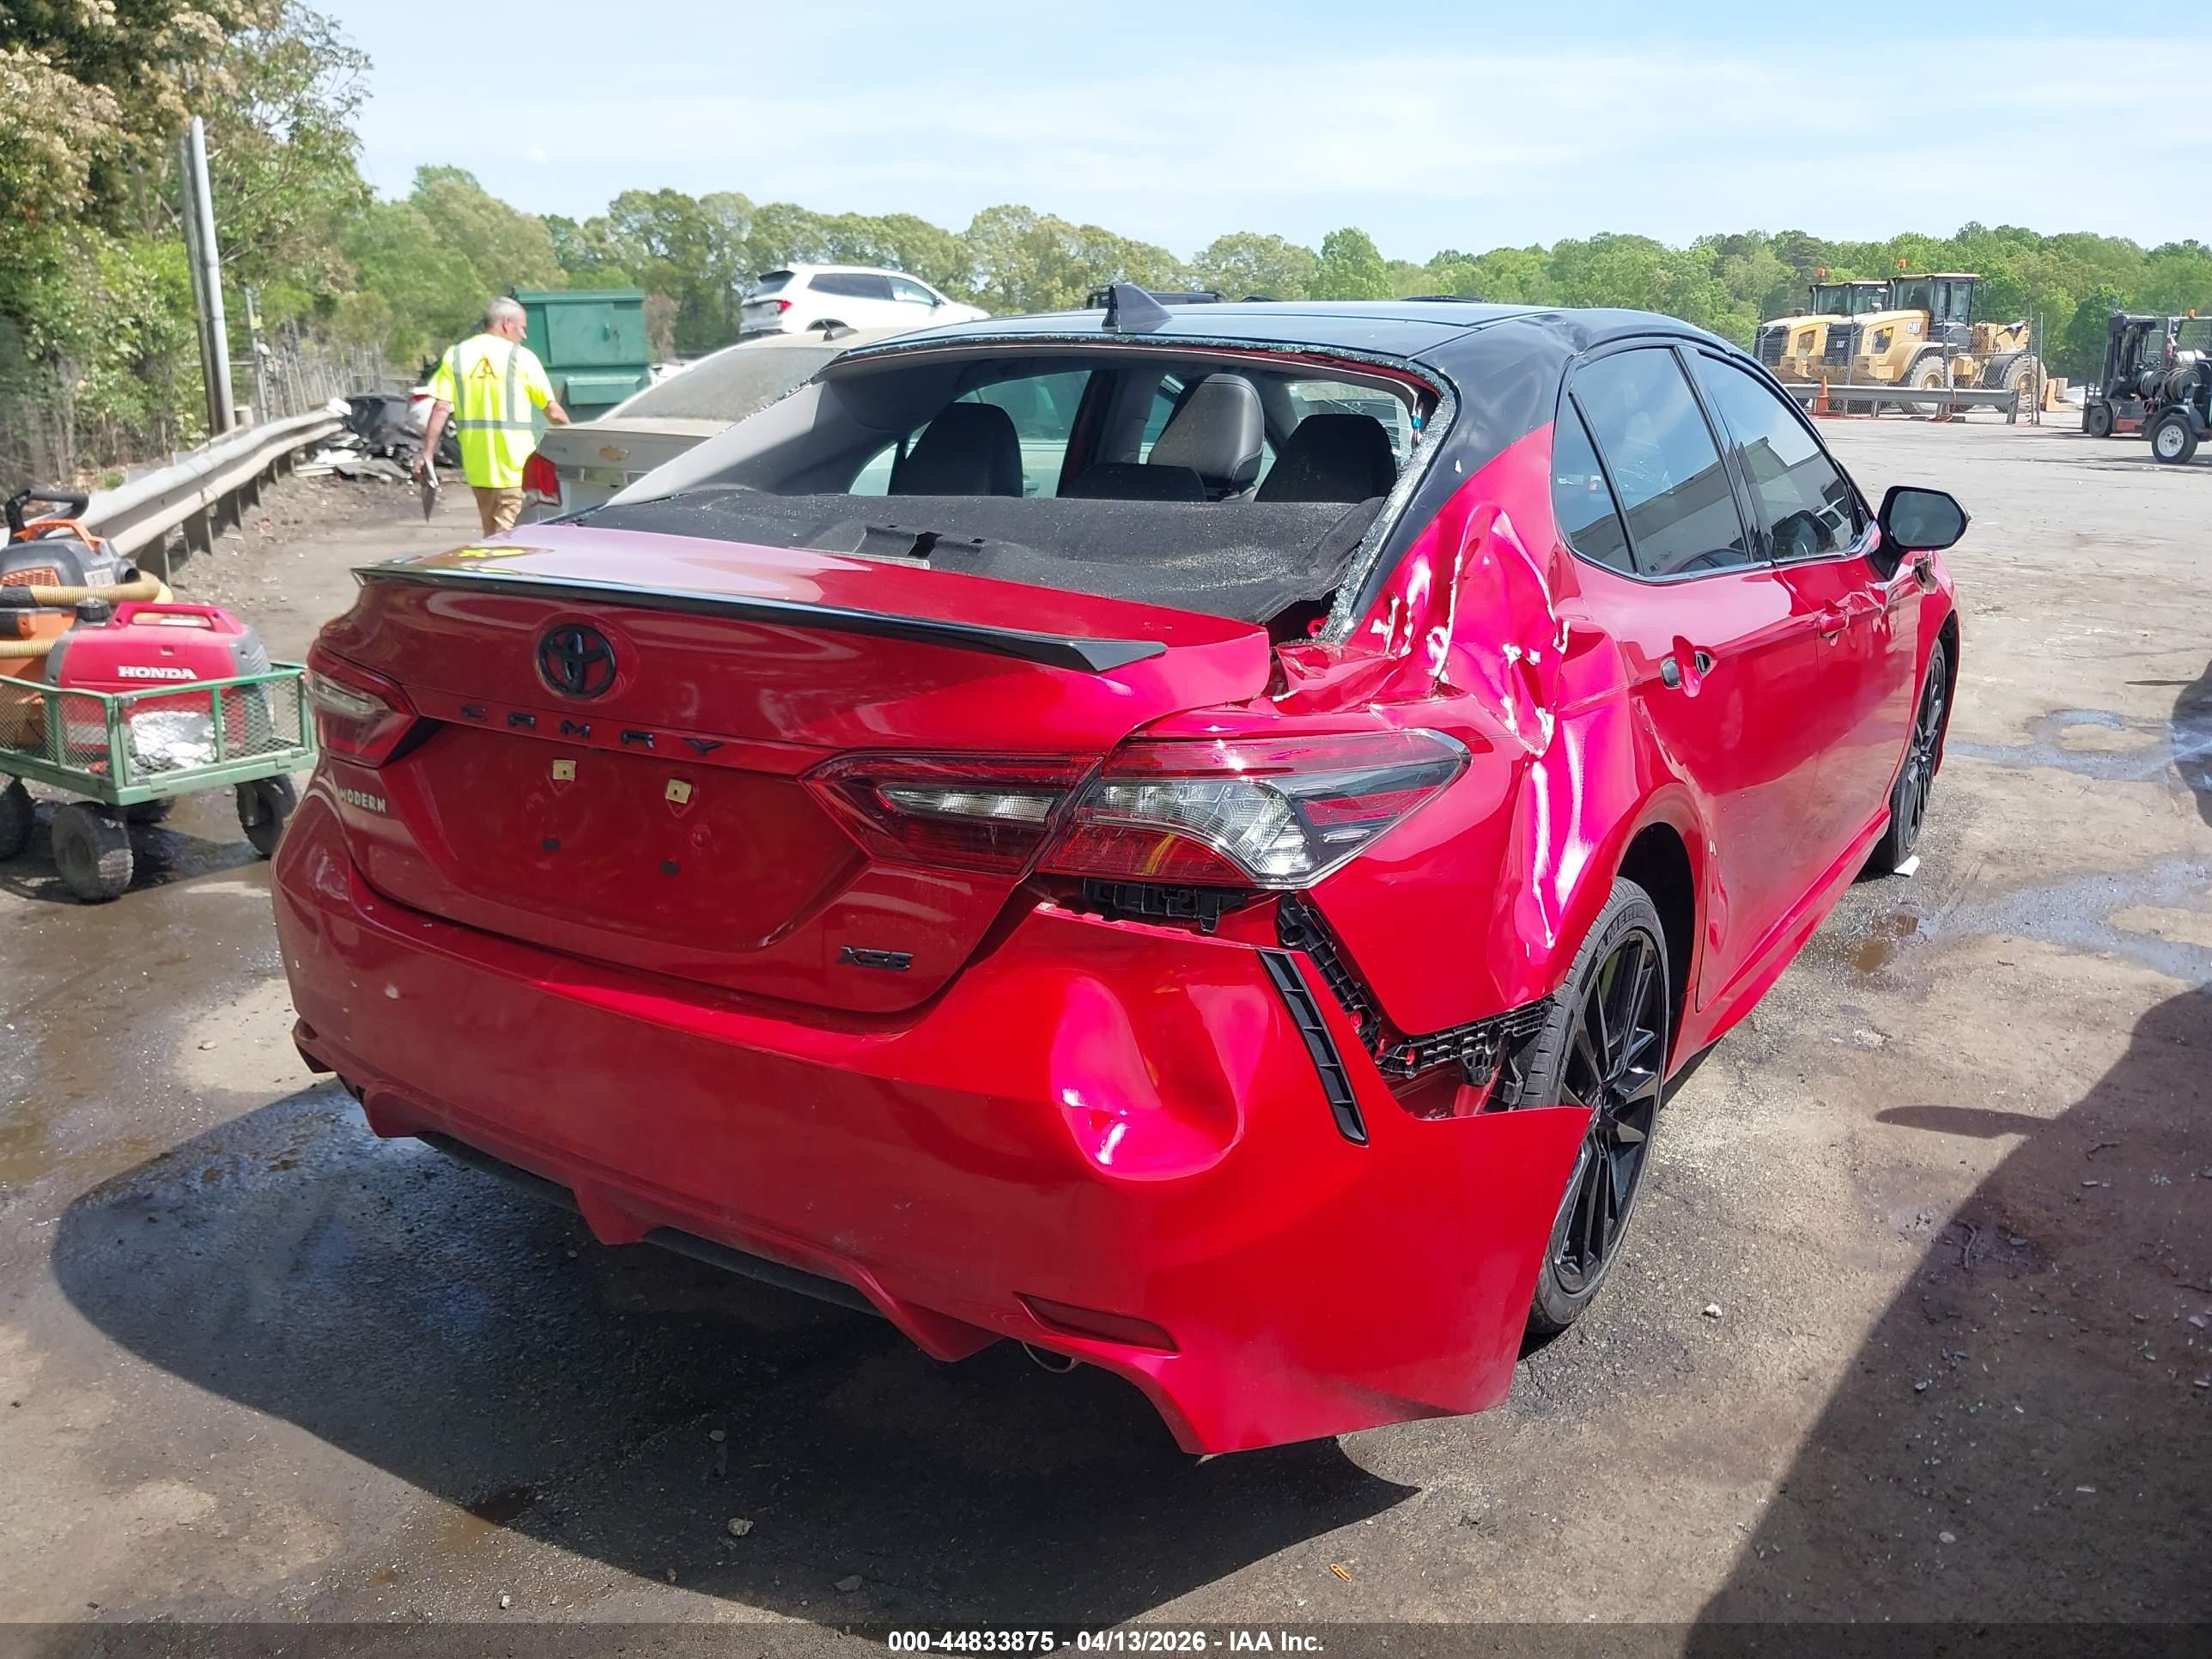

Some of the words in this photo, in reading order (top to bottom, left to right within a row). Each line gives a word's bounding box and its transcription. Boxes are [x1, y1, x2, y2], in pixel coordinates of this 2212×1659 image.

[1907, 322, 1922, 334] CAT
[118, 665, 198, 680] HONDA
[462, 703, 725, 756] CAMRY
[338, 788, 386, 813] MODERN
[838, 945, 914, 971] XSE
